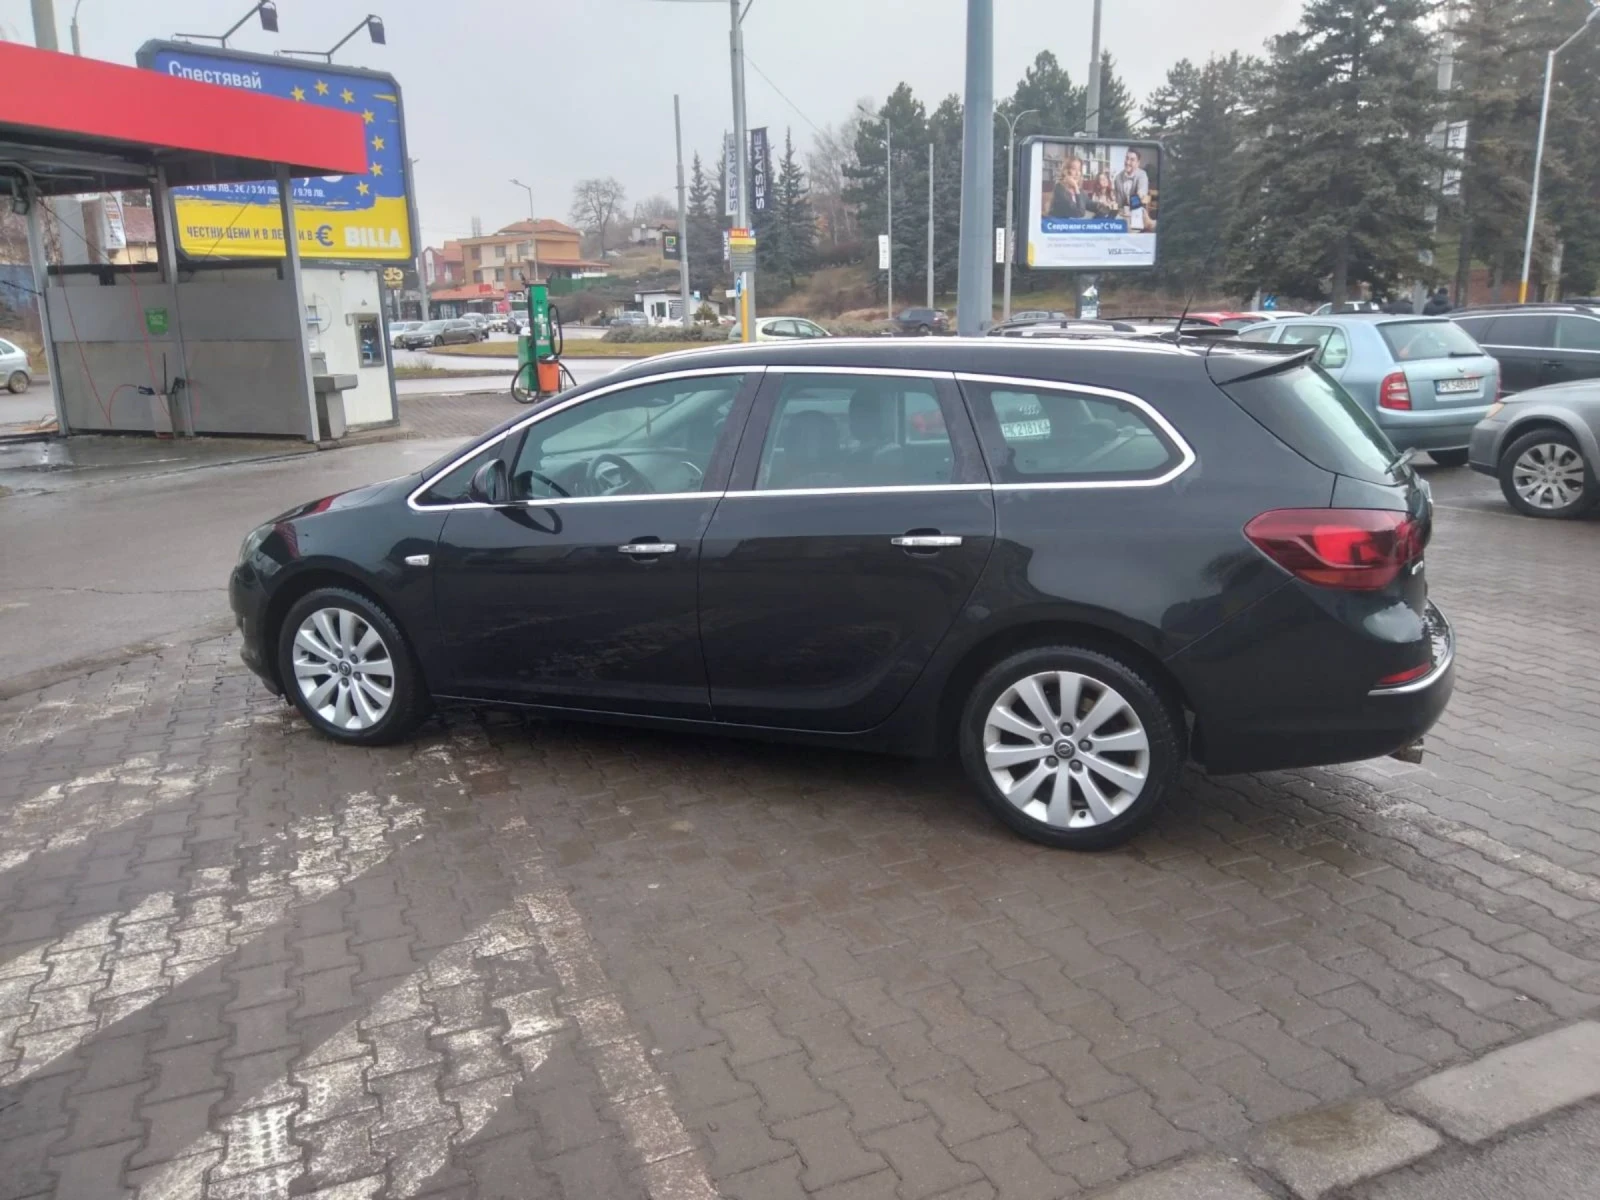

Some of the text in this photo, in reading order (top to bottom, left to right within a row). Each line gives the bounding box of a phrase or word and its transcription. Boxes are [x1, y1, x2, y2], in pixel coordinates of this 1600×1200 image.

[168, 60, 262, 89] Спестявай
[729, 139, 738, 211] SESAME
[754, 132, 765, 210] SESAME
[186, 226, 224, 239] ЧЕСТНИ
[226, 227, 251, 240] ЦЕНИ
[253, 229, 260, 240] И
[263, 229, 268, 240] В
[298, 229, 305, 240] И
[307, 229, 313, 240] В
[344, 227, 403, 249] BILLA
